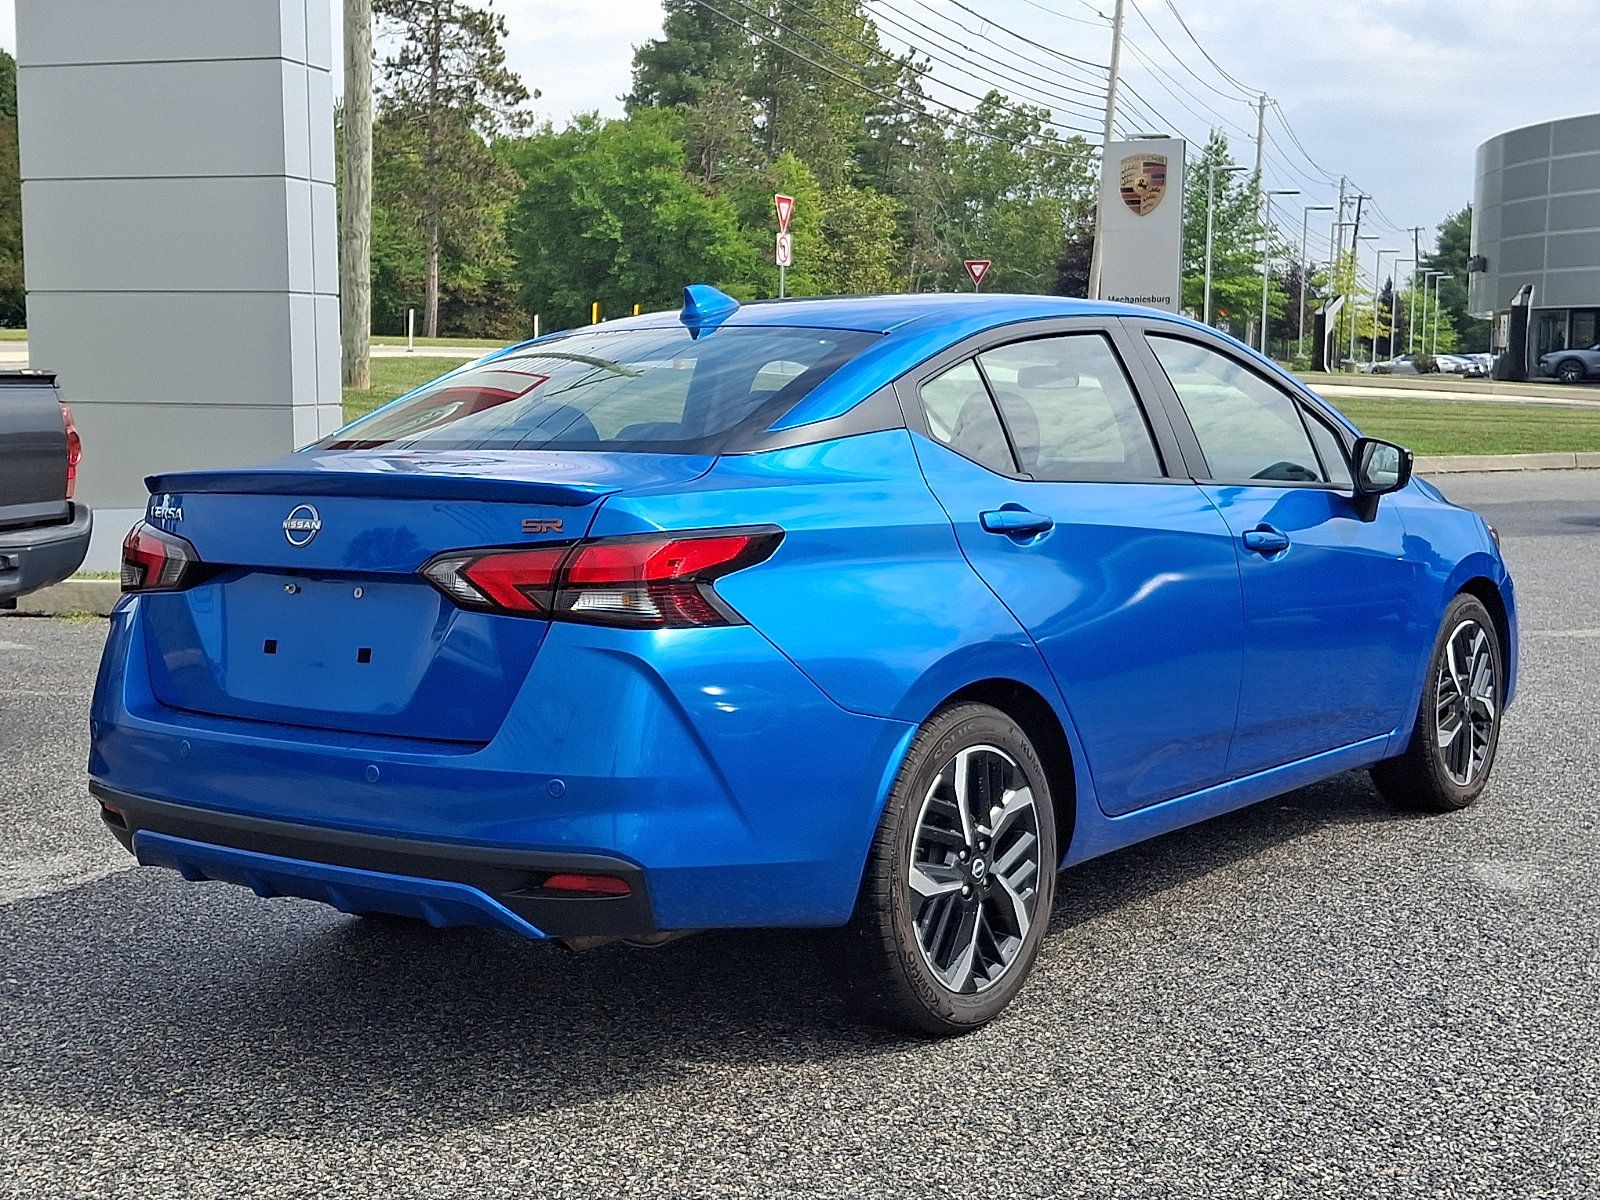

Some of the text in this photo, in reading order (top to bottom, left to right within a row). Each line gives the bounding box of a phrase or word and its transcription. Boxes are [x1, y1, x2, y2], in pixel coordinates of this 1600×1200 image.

[1107, 295, 1171, 305] Mechanicsburg
[282, 519, 321, 530] NISSAN
[521, 518, 564, 533] SR
[906, 950, 941, 1006] KUMHO
